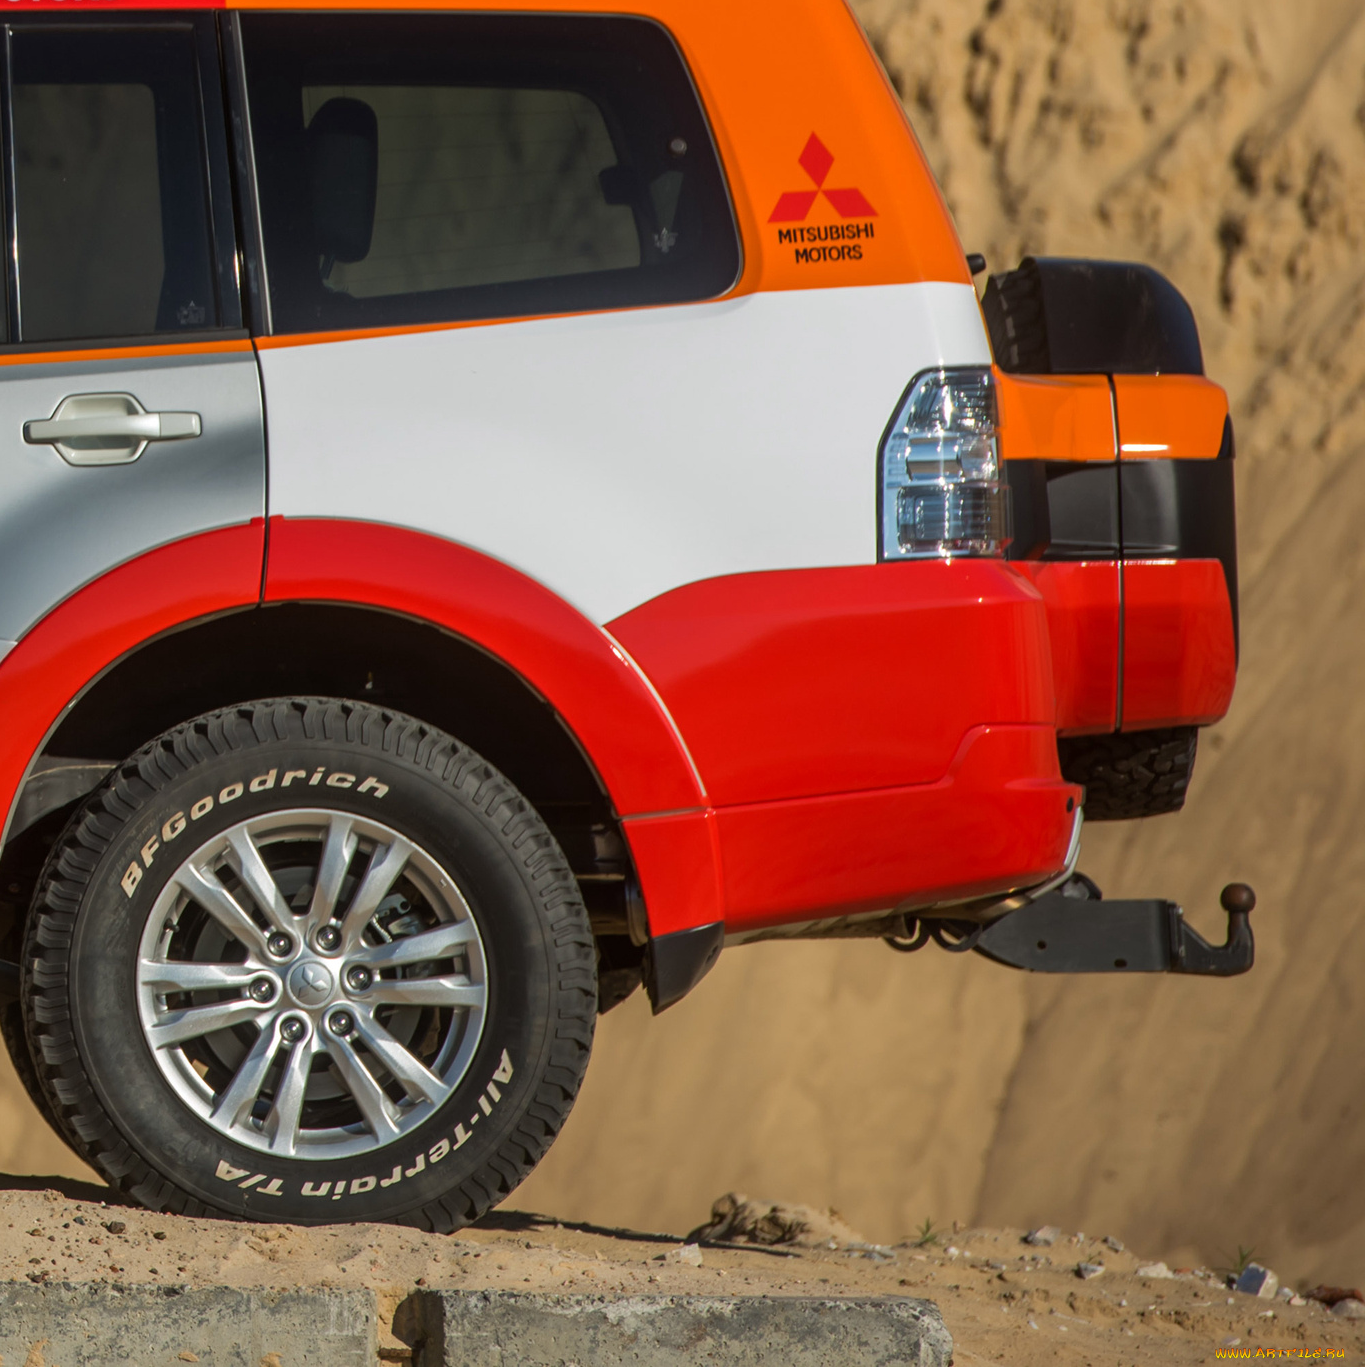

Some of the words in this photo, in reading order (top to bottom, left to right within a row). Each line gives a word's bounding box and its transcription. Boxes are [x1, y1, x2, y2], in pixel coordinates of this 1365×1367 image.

[777, 222, 875, 244] MITSUBISHI
[794, 244, 863, 264] MOTORS
[120, 766, 390, 899] BFGoodrich
[300, 1048, 515, 1200] All-Terrain
[215, 1158, 284, 1197] T/A
